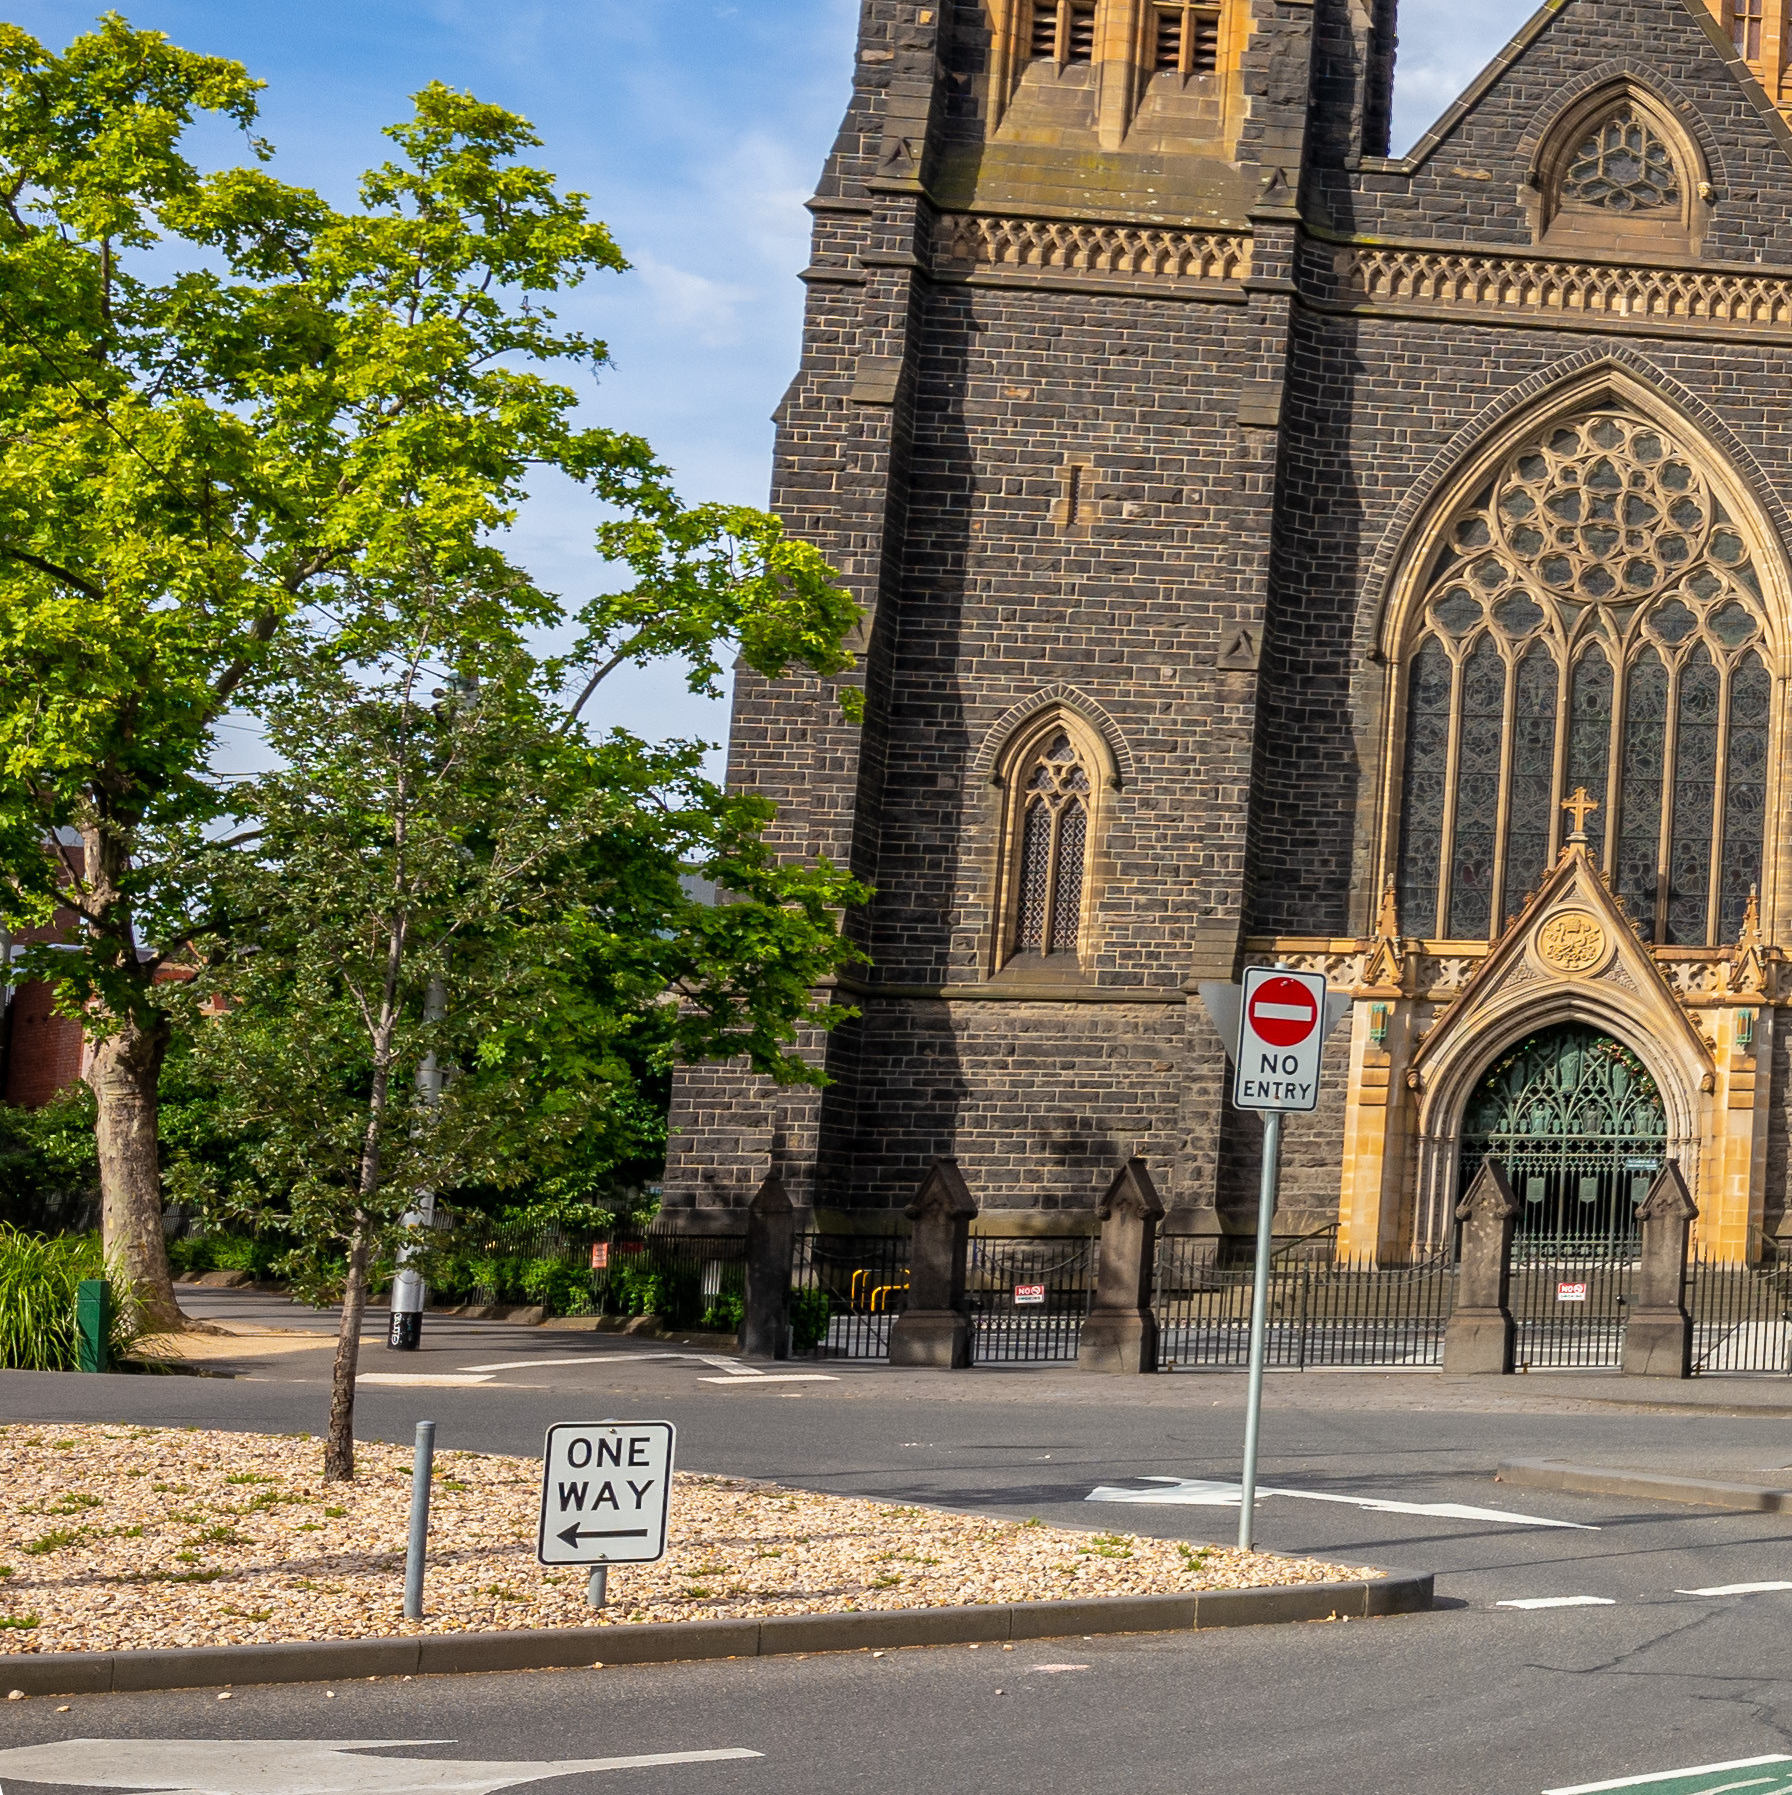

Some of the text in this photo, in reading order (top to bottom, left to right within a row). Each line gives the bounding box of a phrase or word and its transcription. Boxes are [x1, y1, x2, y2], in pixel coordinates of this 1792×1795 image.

[1260, 1053, 1299, 1075] NO
[1243, 1080, 1311, 1100] ENTRY
[1018, 1287, 1030, 1295] NO
[567, 1436, 651, 1469] ONE
[558, 1479, 655, 1512] WAY
